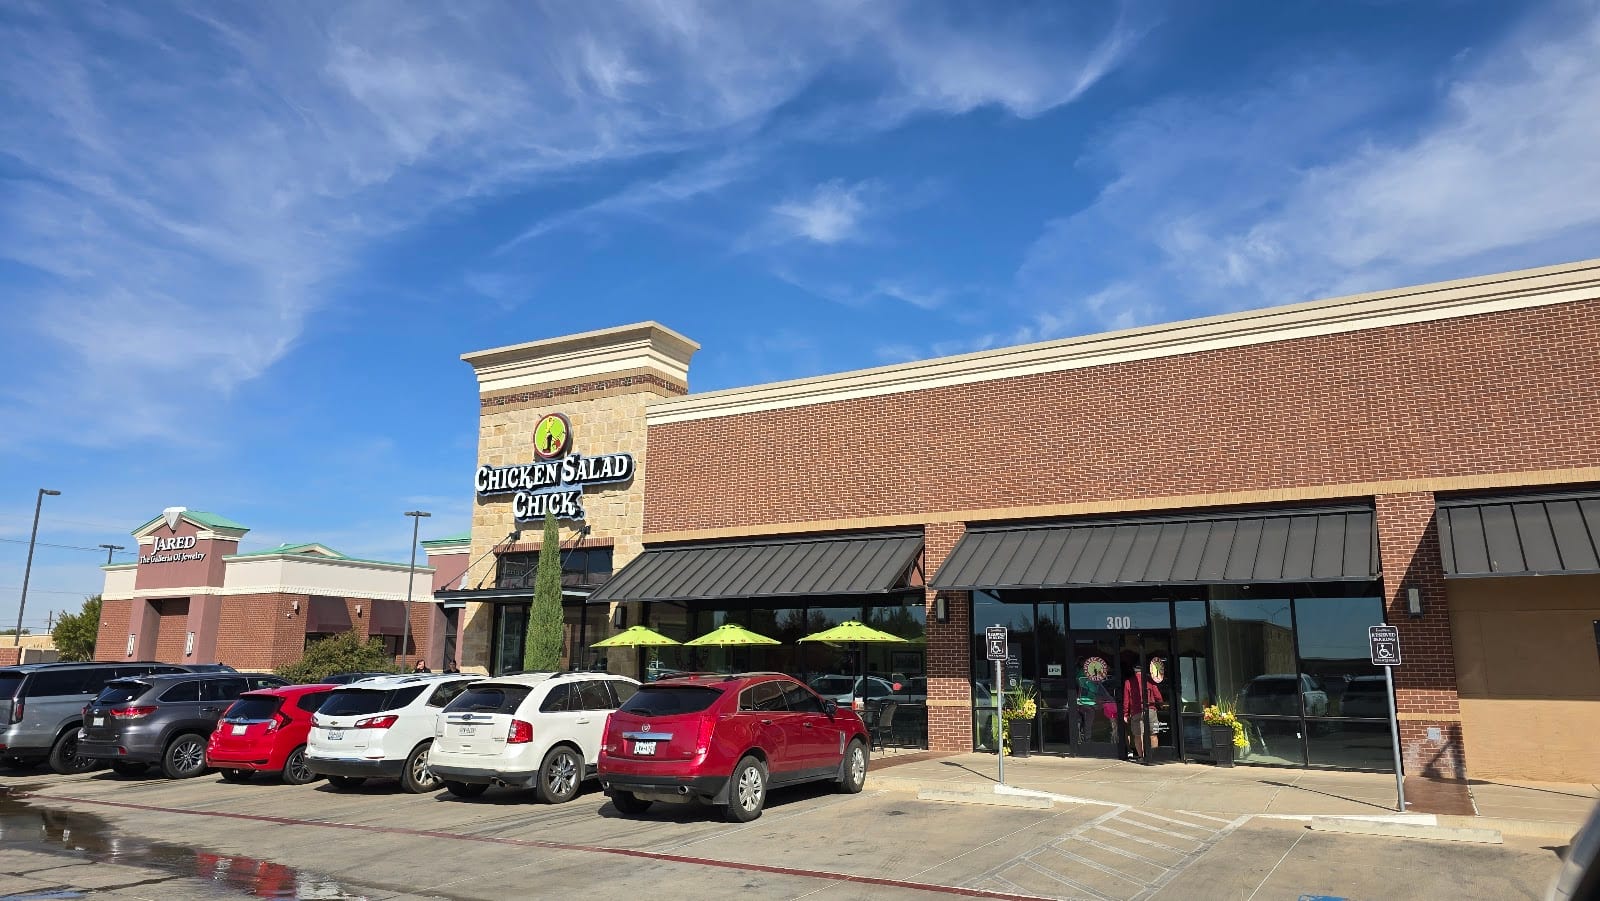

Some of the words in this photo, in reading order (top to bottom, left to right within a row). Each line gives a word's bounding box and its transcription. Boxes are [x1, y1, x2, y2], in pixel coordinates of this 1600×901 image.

[475, 463, 558, 492] CHICKEN
[561, 455, 628, 482] SALAD
[513, 491, 577, 518] CHICK
[151, 536, 196, 554] JARED
[140, 555, 150, 564] The
[181, 552, 205, 563] Jewelry
[1106, 616, 1131, 630] 300
